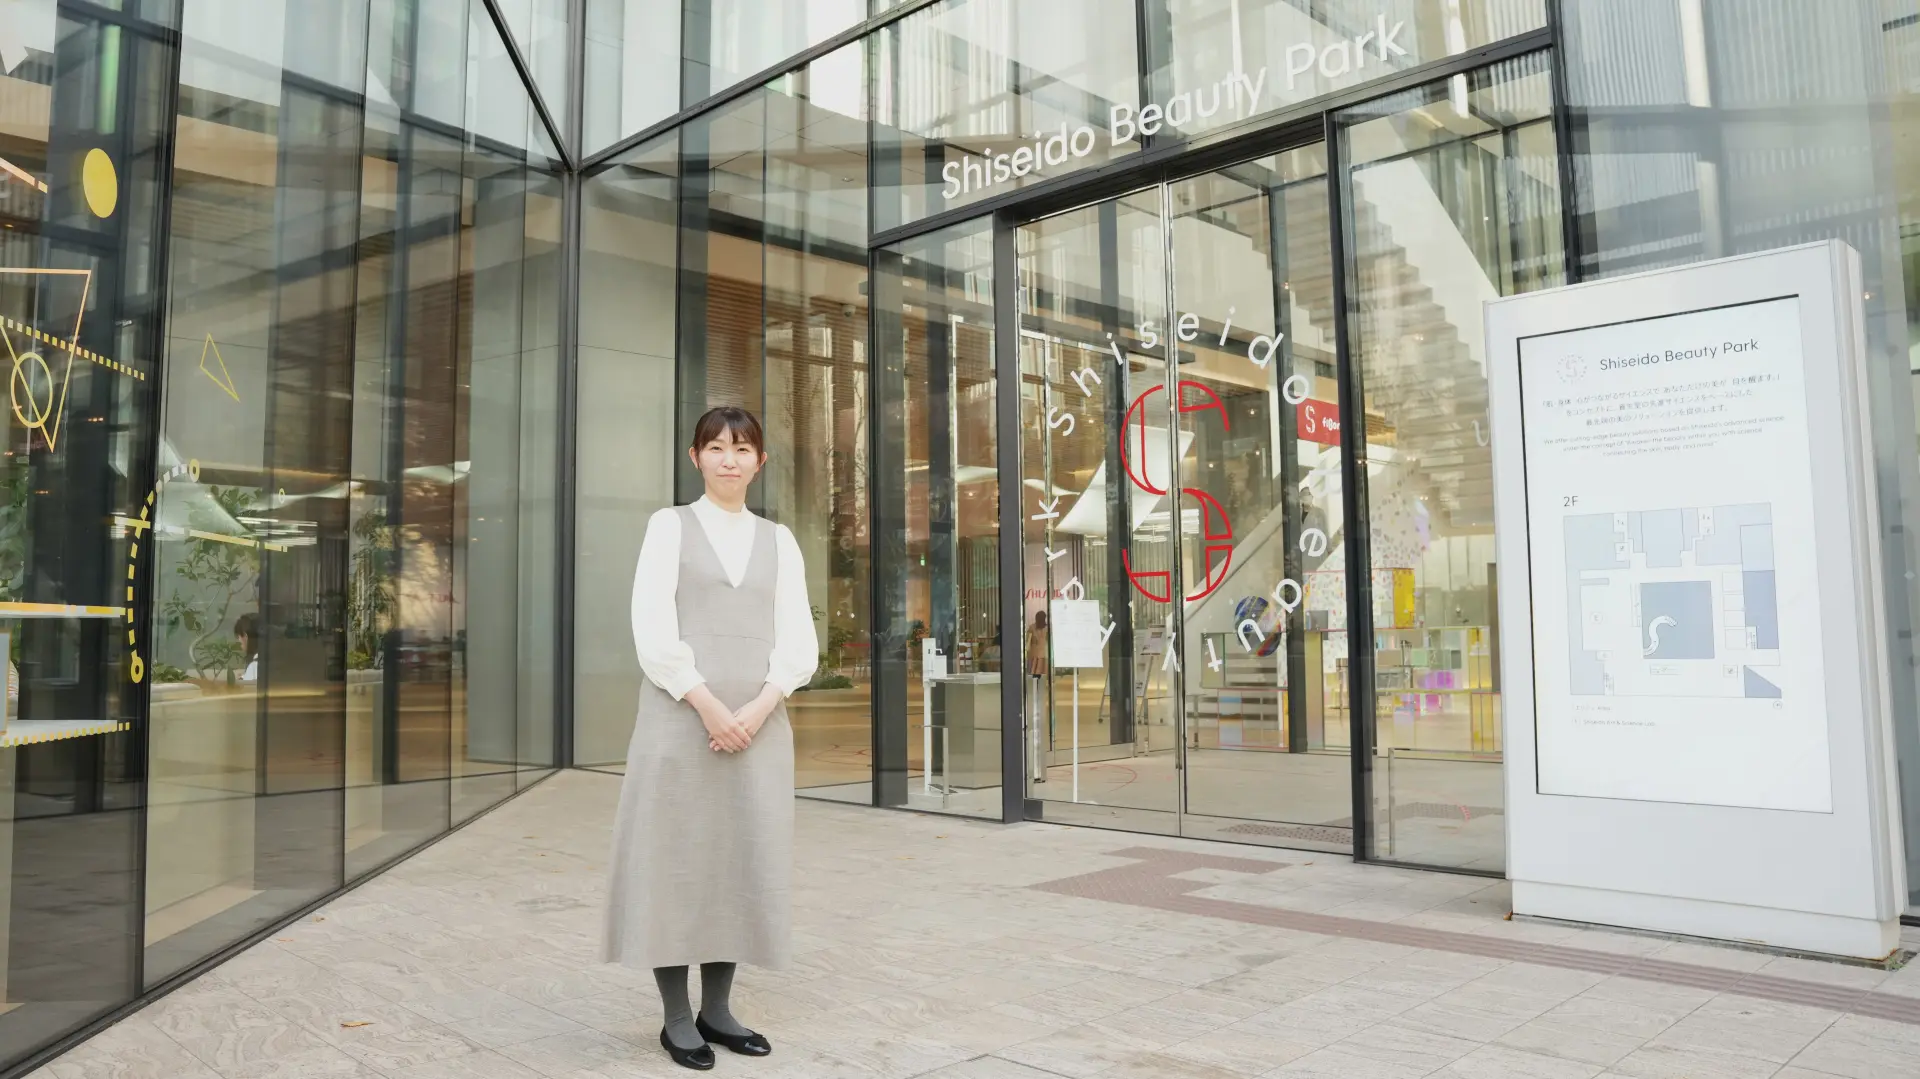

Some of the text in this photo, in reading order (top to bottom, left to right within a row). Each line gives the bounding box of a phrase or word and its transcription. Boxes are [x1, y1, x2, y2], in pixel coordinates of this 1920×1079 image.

[941, 13, 1409, 199] Shiseido Beauty Park
[1047, 305, 1309, 436] Shiseido
[1599, 354, 1660, 371] Shiseido
[1665, 345, 1718, 362] Beauty
[1722, 338, 1760, 354] Park
[1563, 495, 1579, 508] 2F
